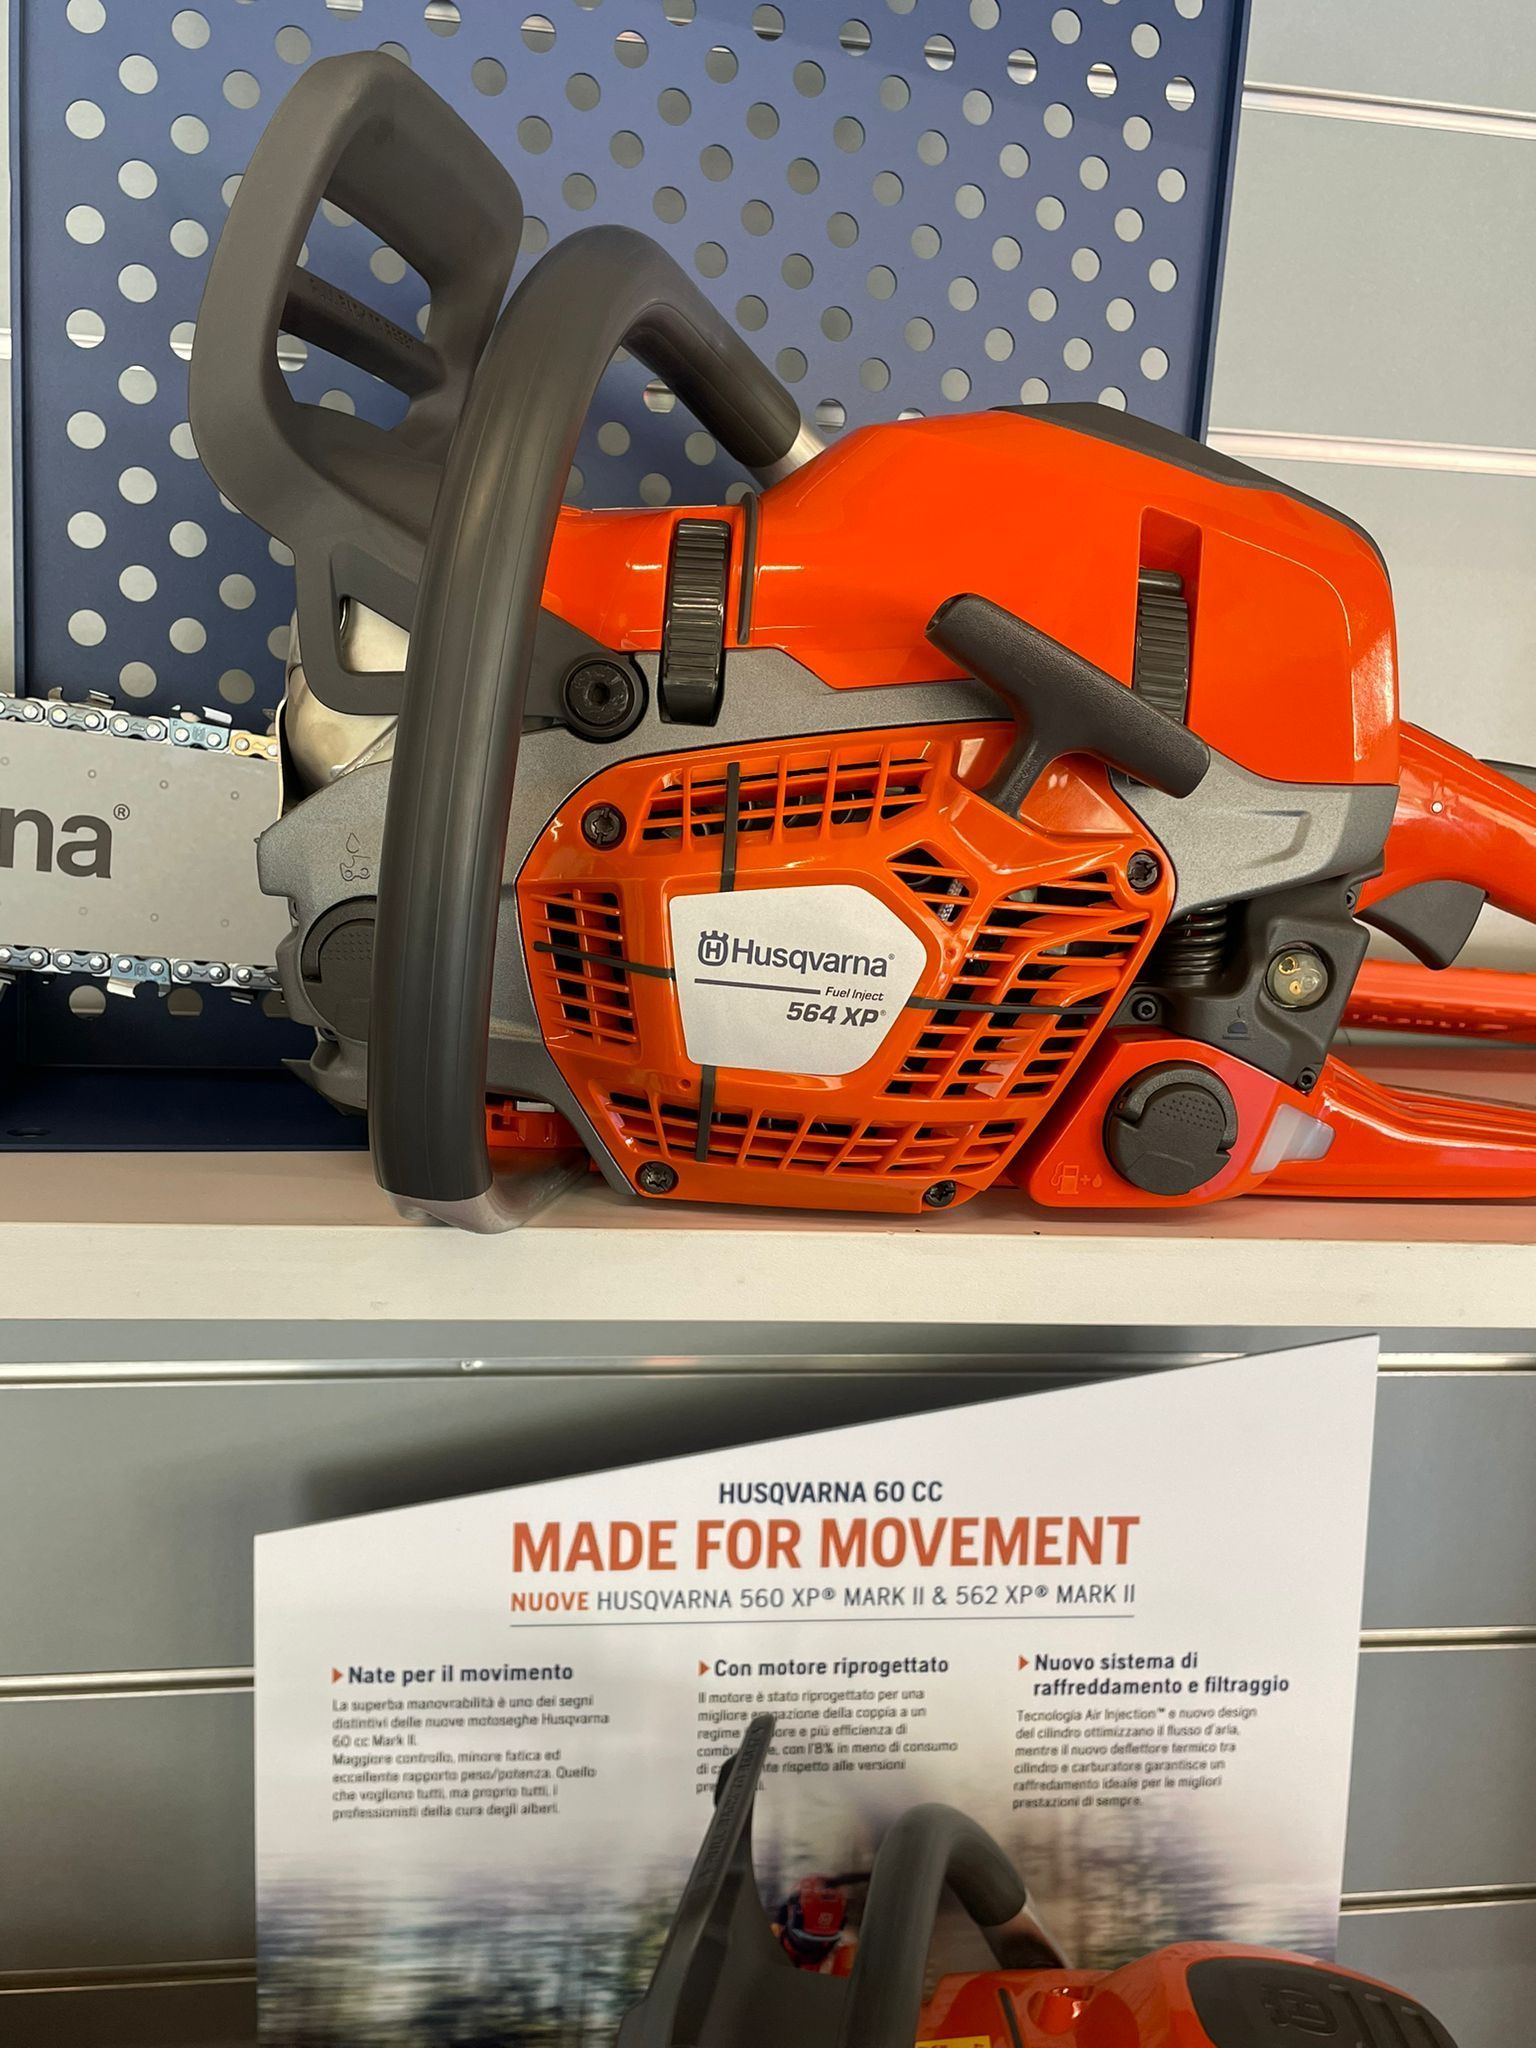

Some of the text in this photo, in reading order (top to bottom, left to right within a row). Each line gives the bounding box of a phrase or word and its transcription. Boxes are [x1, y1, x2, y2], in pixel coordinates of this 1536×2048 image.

[825, 986, 885, 1002] Fuel Inject
[787, 1001, 838, 1024] 564
[718, 1481, 943, 1506] HUSQVARNA 60 CC
[512, 1516, 1141, 1573] MADE FOR MOVEMENT
[510, 1591, 591, 1612] NUOVE
[596, 1589, 734, 1612] HUSQVARNA
[739, 1588, 785, 1608] 560
[843, 1586, 906, 1606] MARK
[912, 1586, 925, 1605] II
[931, 1586, 948, 1605] &
[955, 1585, 999, 1605] 562
[1055, 1584, 1117, 1603] MARK
[1123, 1584, 1135, 1603] II
[713, 1655, 949, 1678] Con motore riprogettato
[1035, 1651, 1197, 1671] Nuovo sistema di
[348, 1662, 574, 1687] Nate per il movimento
[698, 1688, 925, 1704] Il motore è stato riprogettato per una
[1032, 1675, 1290, 1697] raffreddamento e filtraggio
[332, 1694, 593, 1715] La superba manovrabilità è uno dei segni
[332, 1712, 609, 1729] distintivi delle nuove motoseghe Husqvarna
[697, 1705, 926, 1725] migliore egazione della coppia a un
[1017, 1710, 1082, 1725] Tecnologia
[1084, 1708, 1102, 1721] Air
[1167, 1709, 1176, 1719] e
[1178, 1708, 1216, 1718] nuovo
[1217, 1705, 1257, 1720] design
[331, 1735, 352, 1748] 60
[352, 1738, 371, 1747] cc
[371, 1734, 405, 1747] Mark
[696, 1726, 741, 1742] regime
[799, 1728, 806, 1737] e
[810, 1725, 828, 1740] più
[832, 1723, 892, 1736] efficienza
[895, 1722, 908, 1735] di
[1015, 1727, 1035, 1740] del
[1036, 1726, 1082, 1739] cilindro
[1083, 1725, 1155, 1738] ottimizzano
[1156, 1724, 1164, 1736] il
[1166, 1723, 1202, 1736] flusso
[782, 1745, 804, 1755] con
[837, 1741, 848, 1754] in
[851, 1743, 886, 1753] meno
[888, 1740, 900, 1753] di
[902, 1742, 958, 1752] consumo
[1014, 1740, 1237, 1757] mentre il nuovo deflettore termico tra
[332, 1753, 392, 1769] Maggiore
[458, 1750, 501, 1762] minore
[505, 1749, 540, 1761] fatica
[544, 1748, 560, 1761] ed
[697, 1762, 708, 1774] di
[782, 1760, 830, 1776] rispetto
[832, 1759, 855, 1771] alle
[857, 1758, 906, 1770] versioni
[1014, 1758, 1225, 1775] cilindro e carburatore garantisce un
[332, 1770, 399, 1783] eccellente
[402, 1769, 457, 1785] rapporto
[555, 1765, 595, 1781] Quello
[1102, 1777, 1139, 1789] ideale
[1141, 1779, 1162, 1792] per
[1163, 1776, 1176, 1788] le
[1177, 1775, 1222, 1791] migliori
[331, 1789, 358, 1801] che
[358, 1788, 415, 1803] vogliono
[448, 1788, 471, 1798] ma
[471, 1785, 519, 1801] proprio
[552, 1784, 558, 1796] i
[1011, 1796, 1080, 1812] prestazioni
[1081, 1794, 1094, 1807] di
[332, 1806, 418, 1822] professionisti
[420, 1805, 452, 1817] della
[454, 1806, 483, 1816] cura
[486, 1803, 516, 1818] degli
